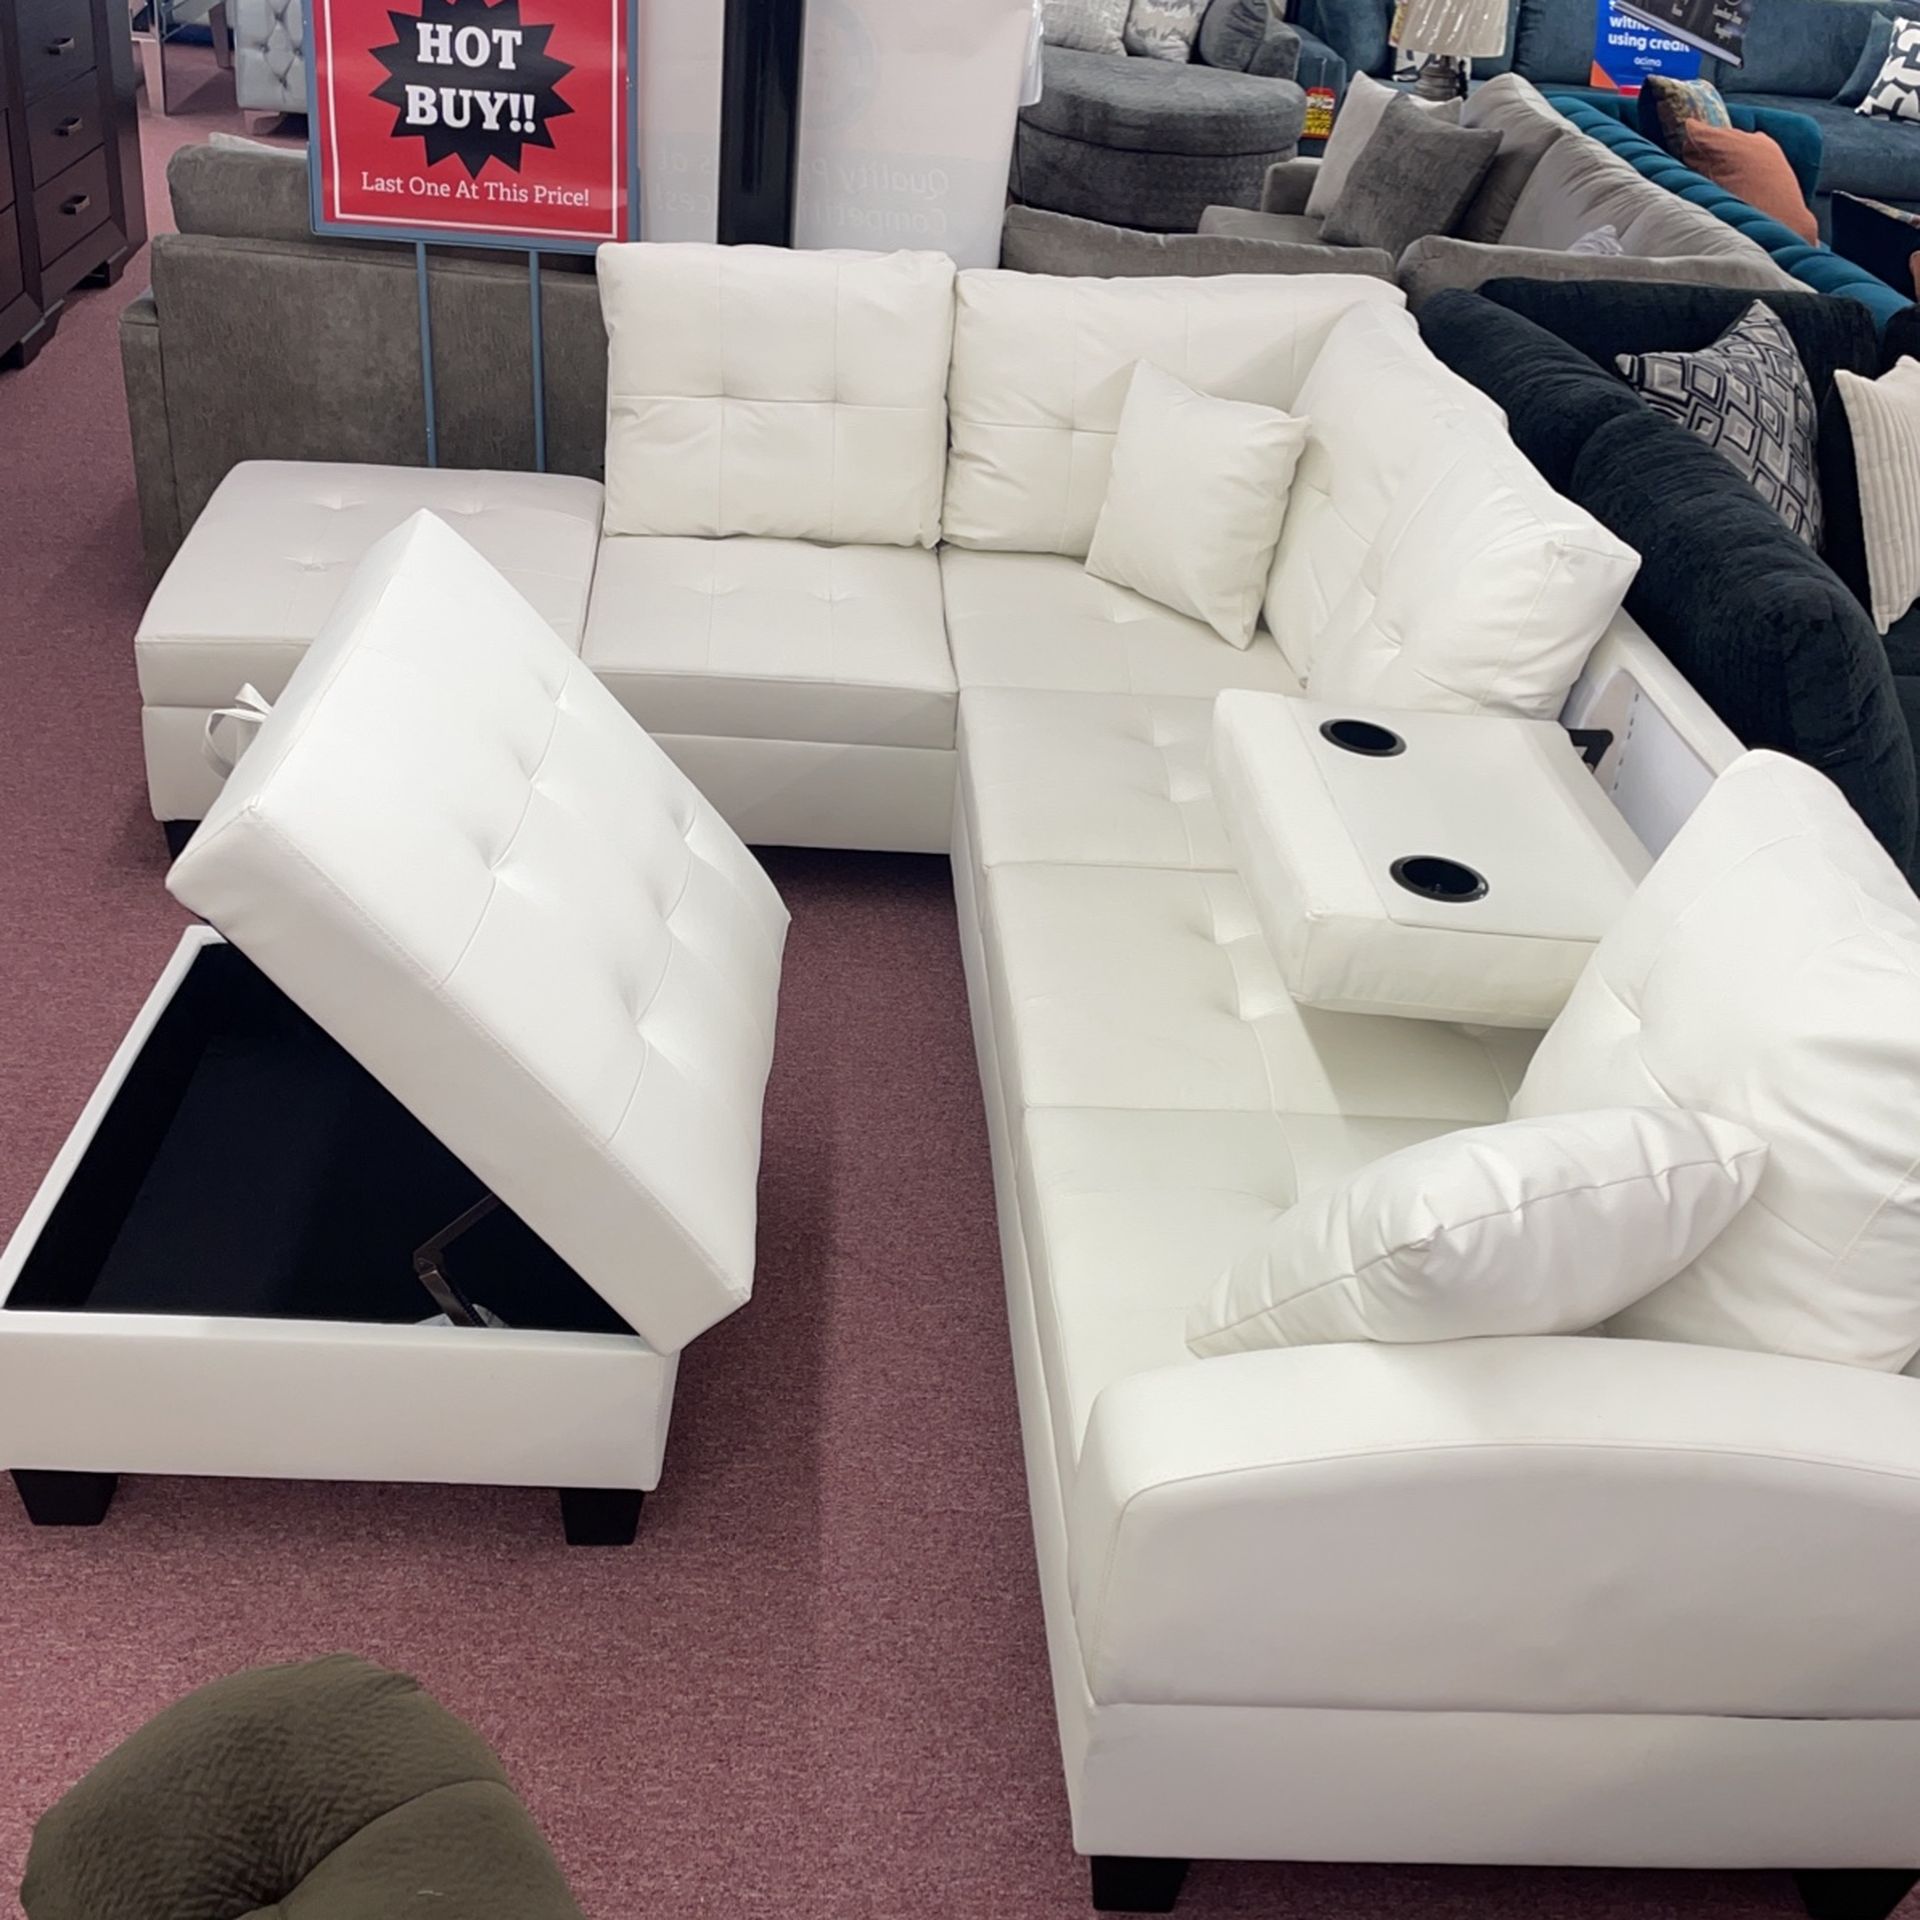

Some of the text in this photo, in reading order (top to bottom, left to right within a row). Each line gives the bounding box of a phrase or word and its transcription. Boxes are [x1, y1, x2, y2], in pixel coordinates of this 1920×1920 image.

[1609, 15, 1656, 32] witho
[416, 22, 522, 70] HOT
[1608, 32, 1648, 52] using
[405, 84, 536, 133] BUY!!
[361, 172, 590, 207] Last One At This Price!
